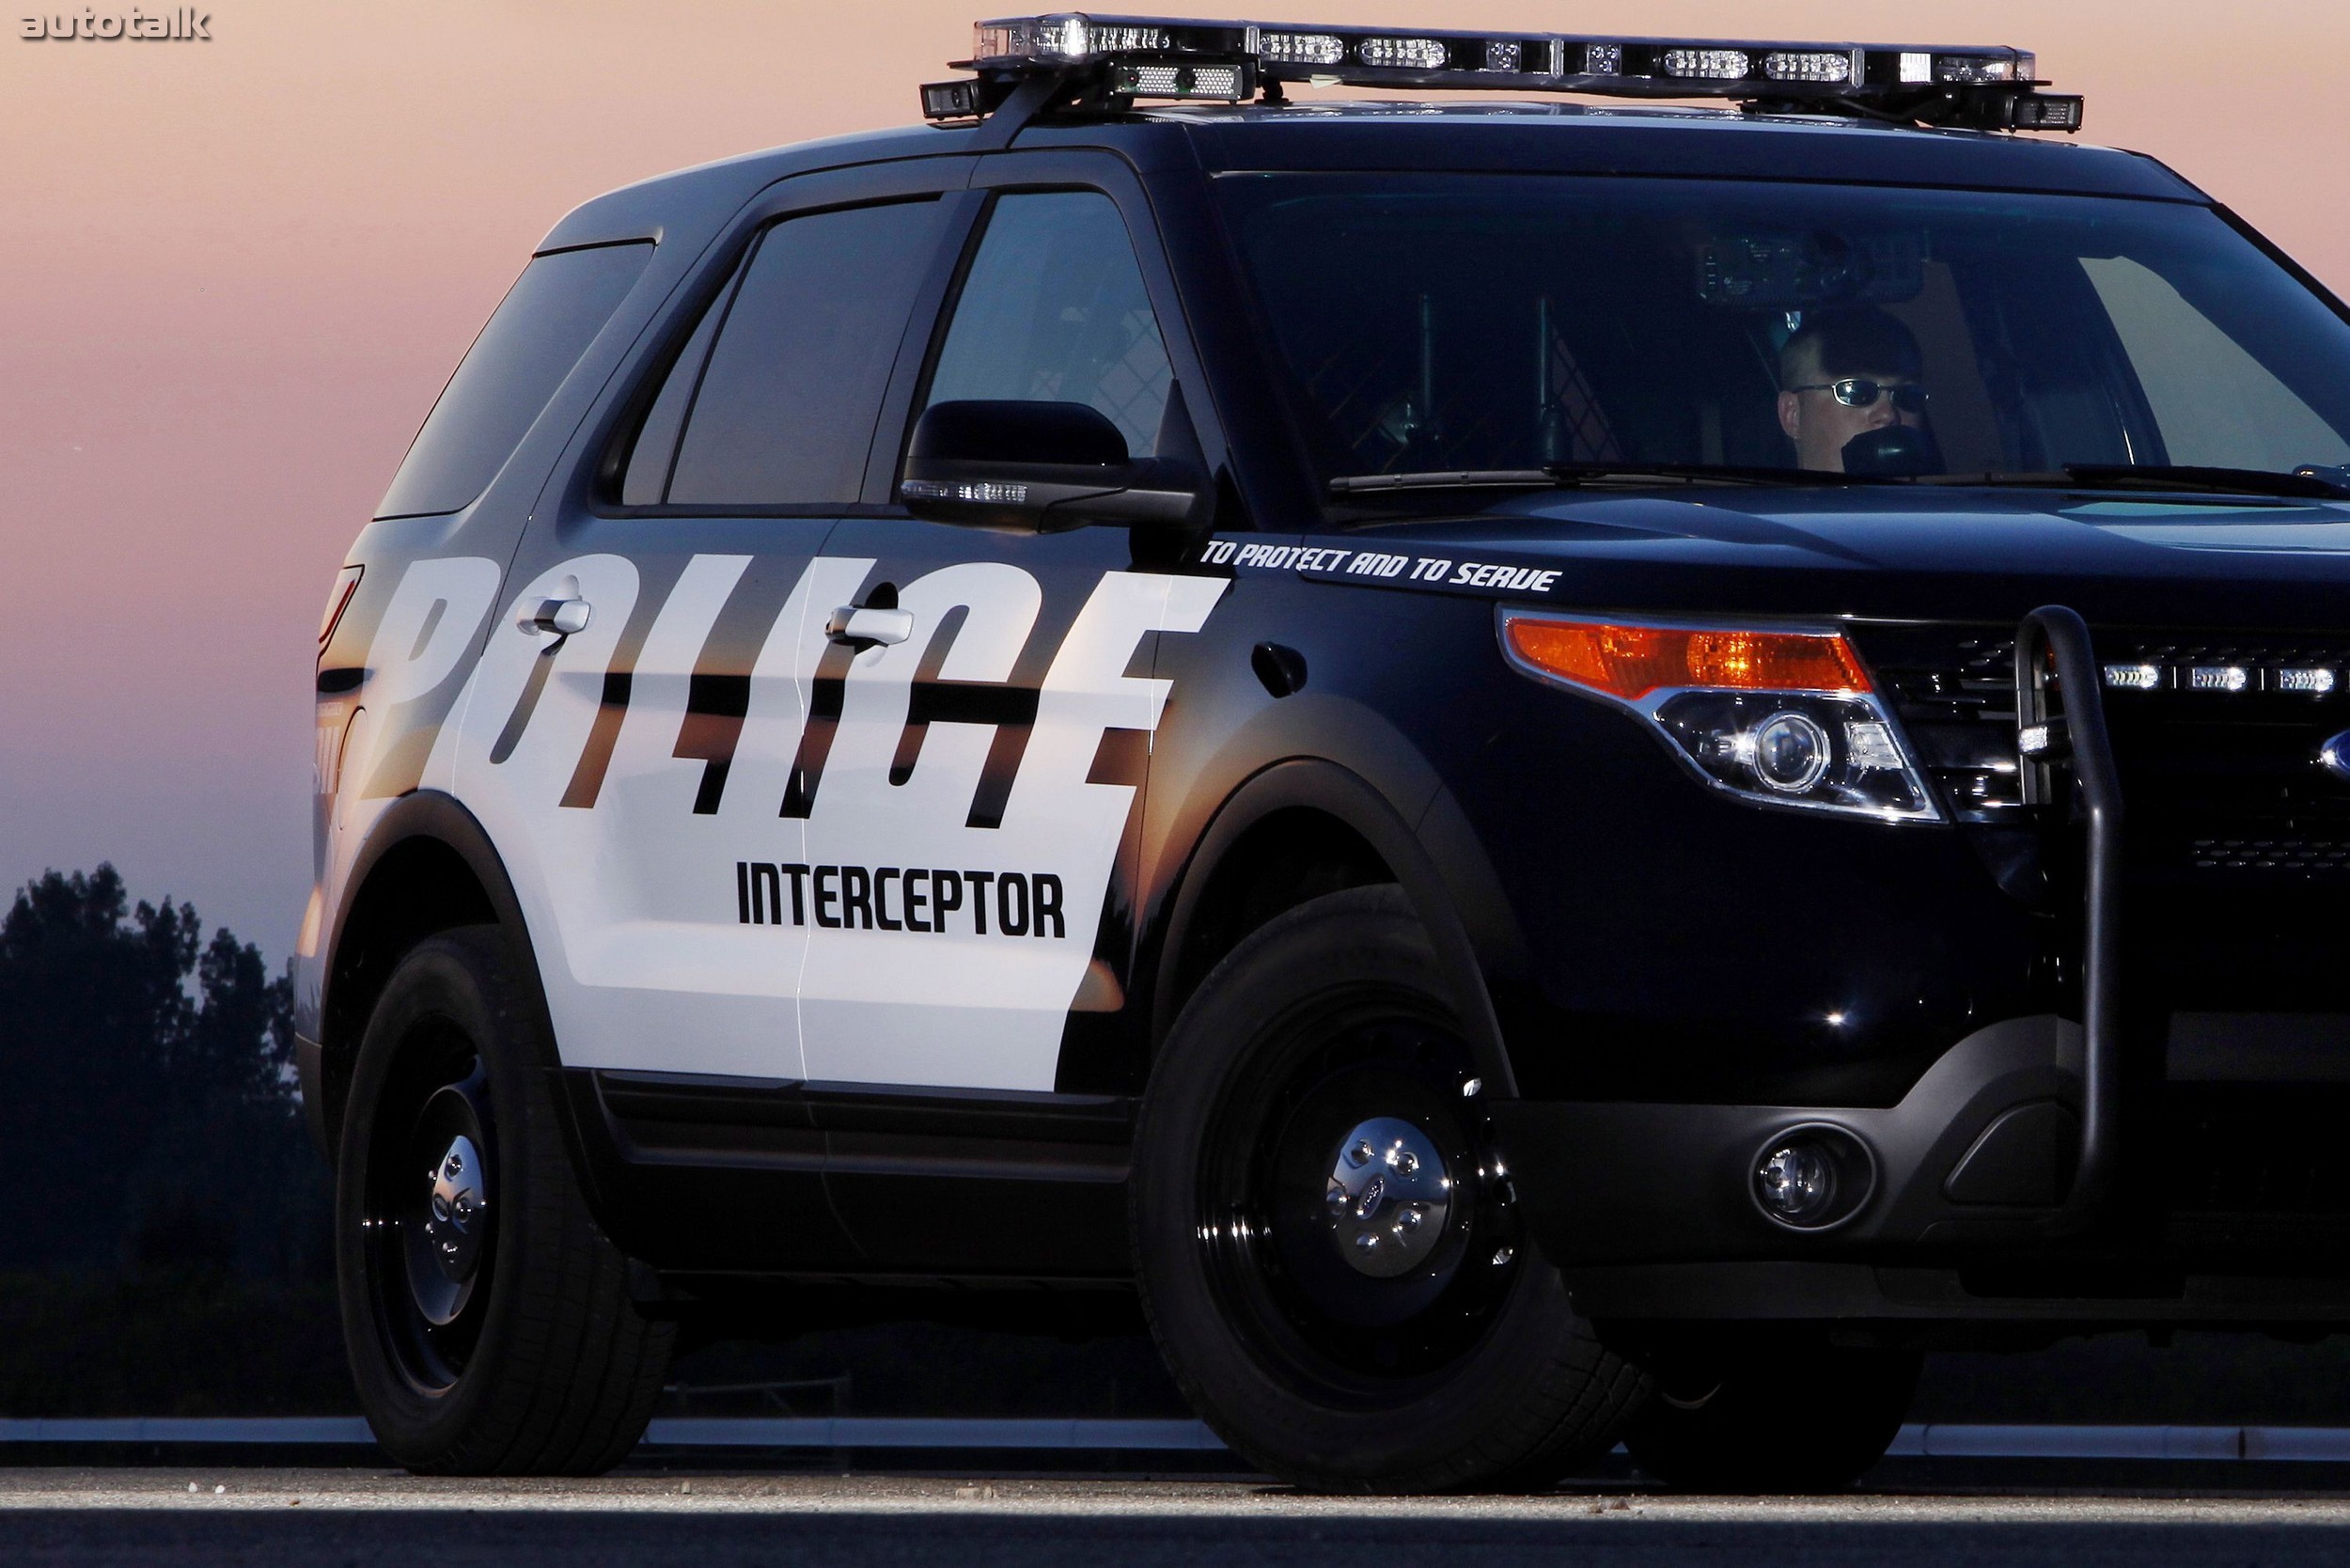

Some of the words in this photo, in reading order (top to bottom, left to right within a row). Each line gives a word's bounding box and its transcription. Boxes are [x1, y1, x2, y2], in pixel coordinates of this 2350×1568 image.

[1200, 541, 1237, 564] TO
[1233, 543, 1352, 572] PROTECT
[1346, 552, 1409, 577] AND
[1409, 557, 1451, 581] TO
[1449, 562, 1562, 592] SERVE
[361, 553, 1231, 829] POLICE
[736, 860, 1066, 939] INTERCEPTOR
